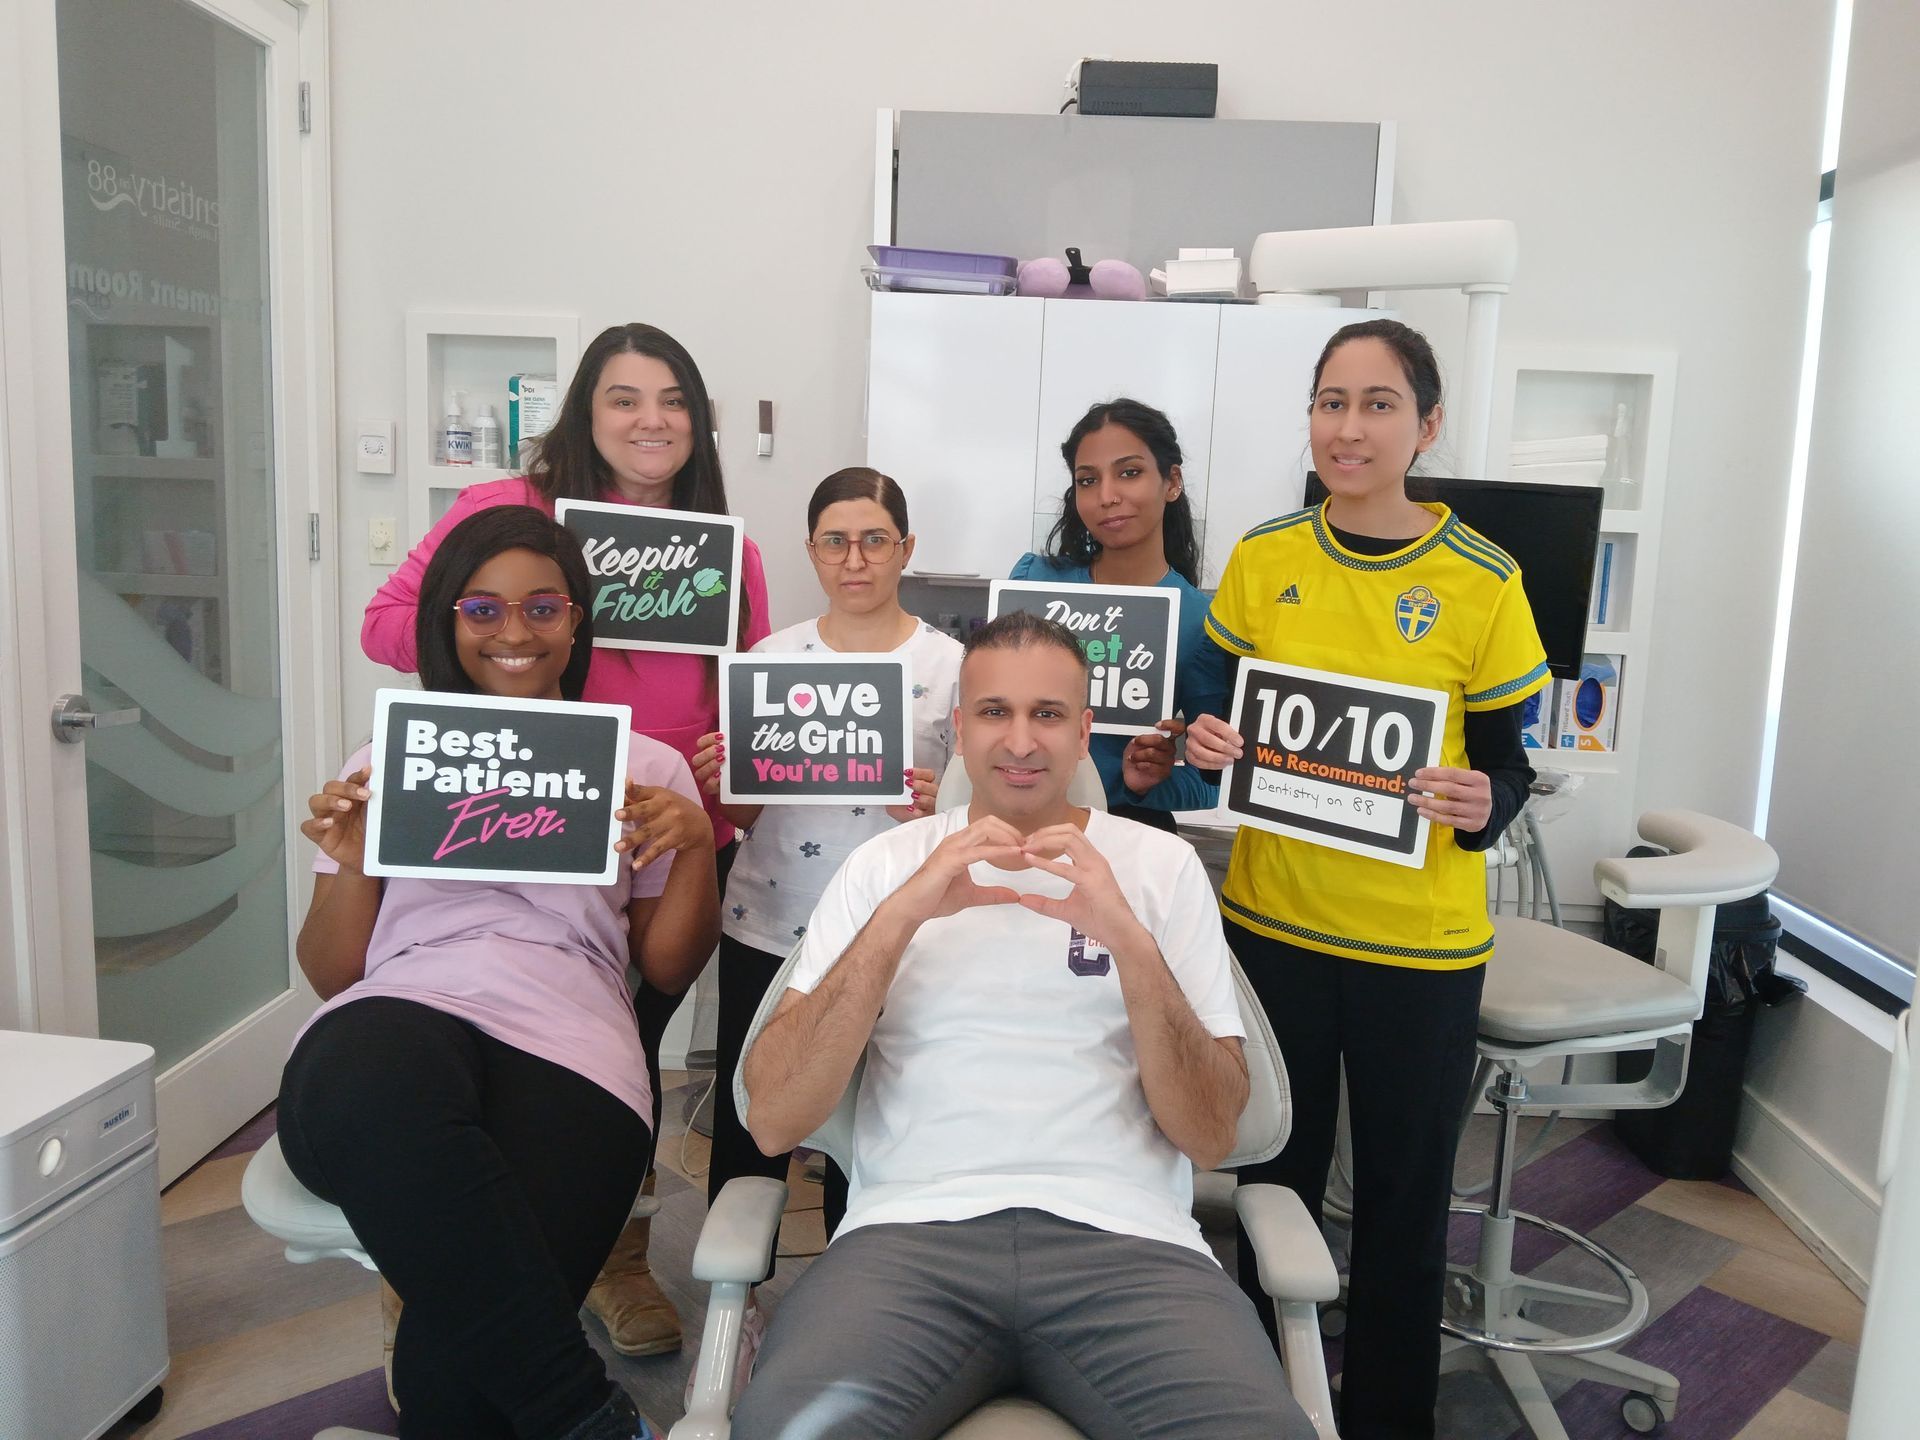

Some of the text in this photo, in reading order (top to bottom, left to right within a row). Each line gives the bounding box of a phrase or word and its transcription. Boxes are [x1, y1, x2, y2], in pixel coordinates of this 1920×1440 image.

[581, 533, 708, 587] Keepin'
[642, 571, 664, 591] it
[592, 578, 698, 622] Fresh
[1044, 600, 1123, 632] Don't
[1126, 643, 1154, 670] to
[753, 671, 881, 717] Love
[1089, 666, 1150, 710] ile
[405, 719, 533, 761] Best.
[751, 720, 883, 754] the Grin
[403, 757, 600, 800] Patient.
[752, 758, 882, 782] You're In!
[1256, 747, 1407, 793] We Recommend:
[1257, 776, 1375, 815] Dentistry on 88
[433, 787, 566, 861] Ever.
[103, 1109, 130, 1130] austin
